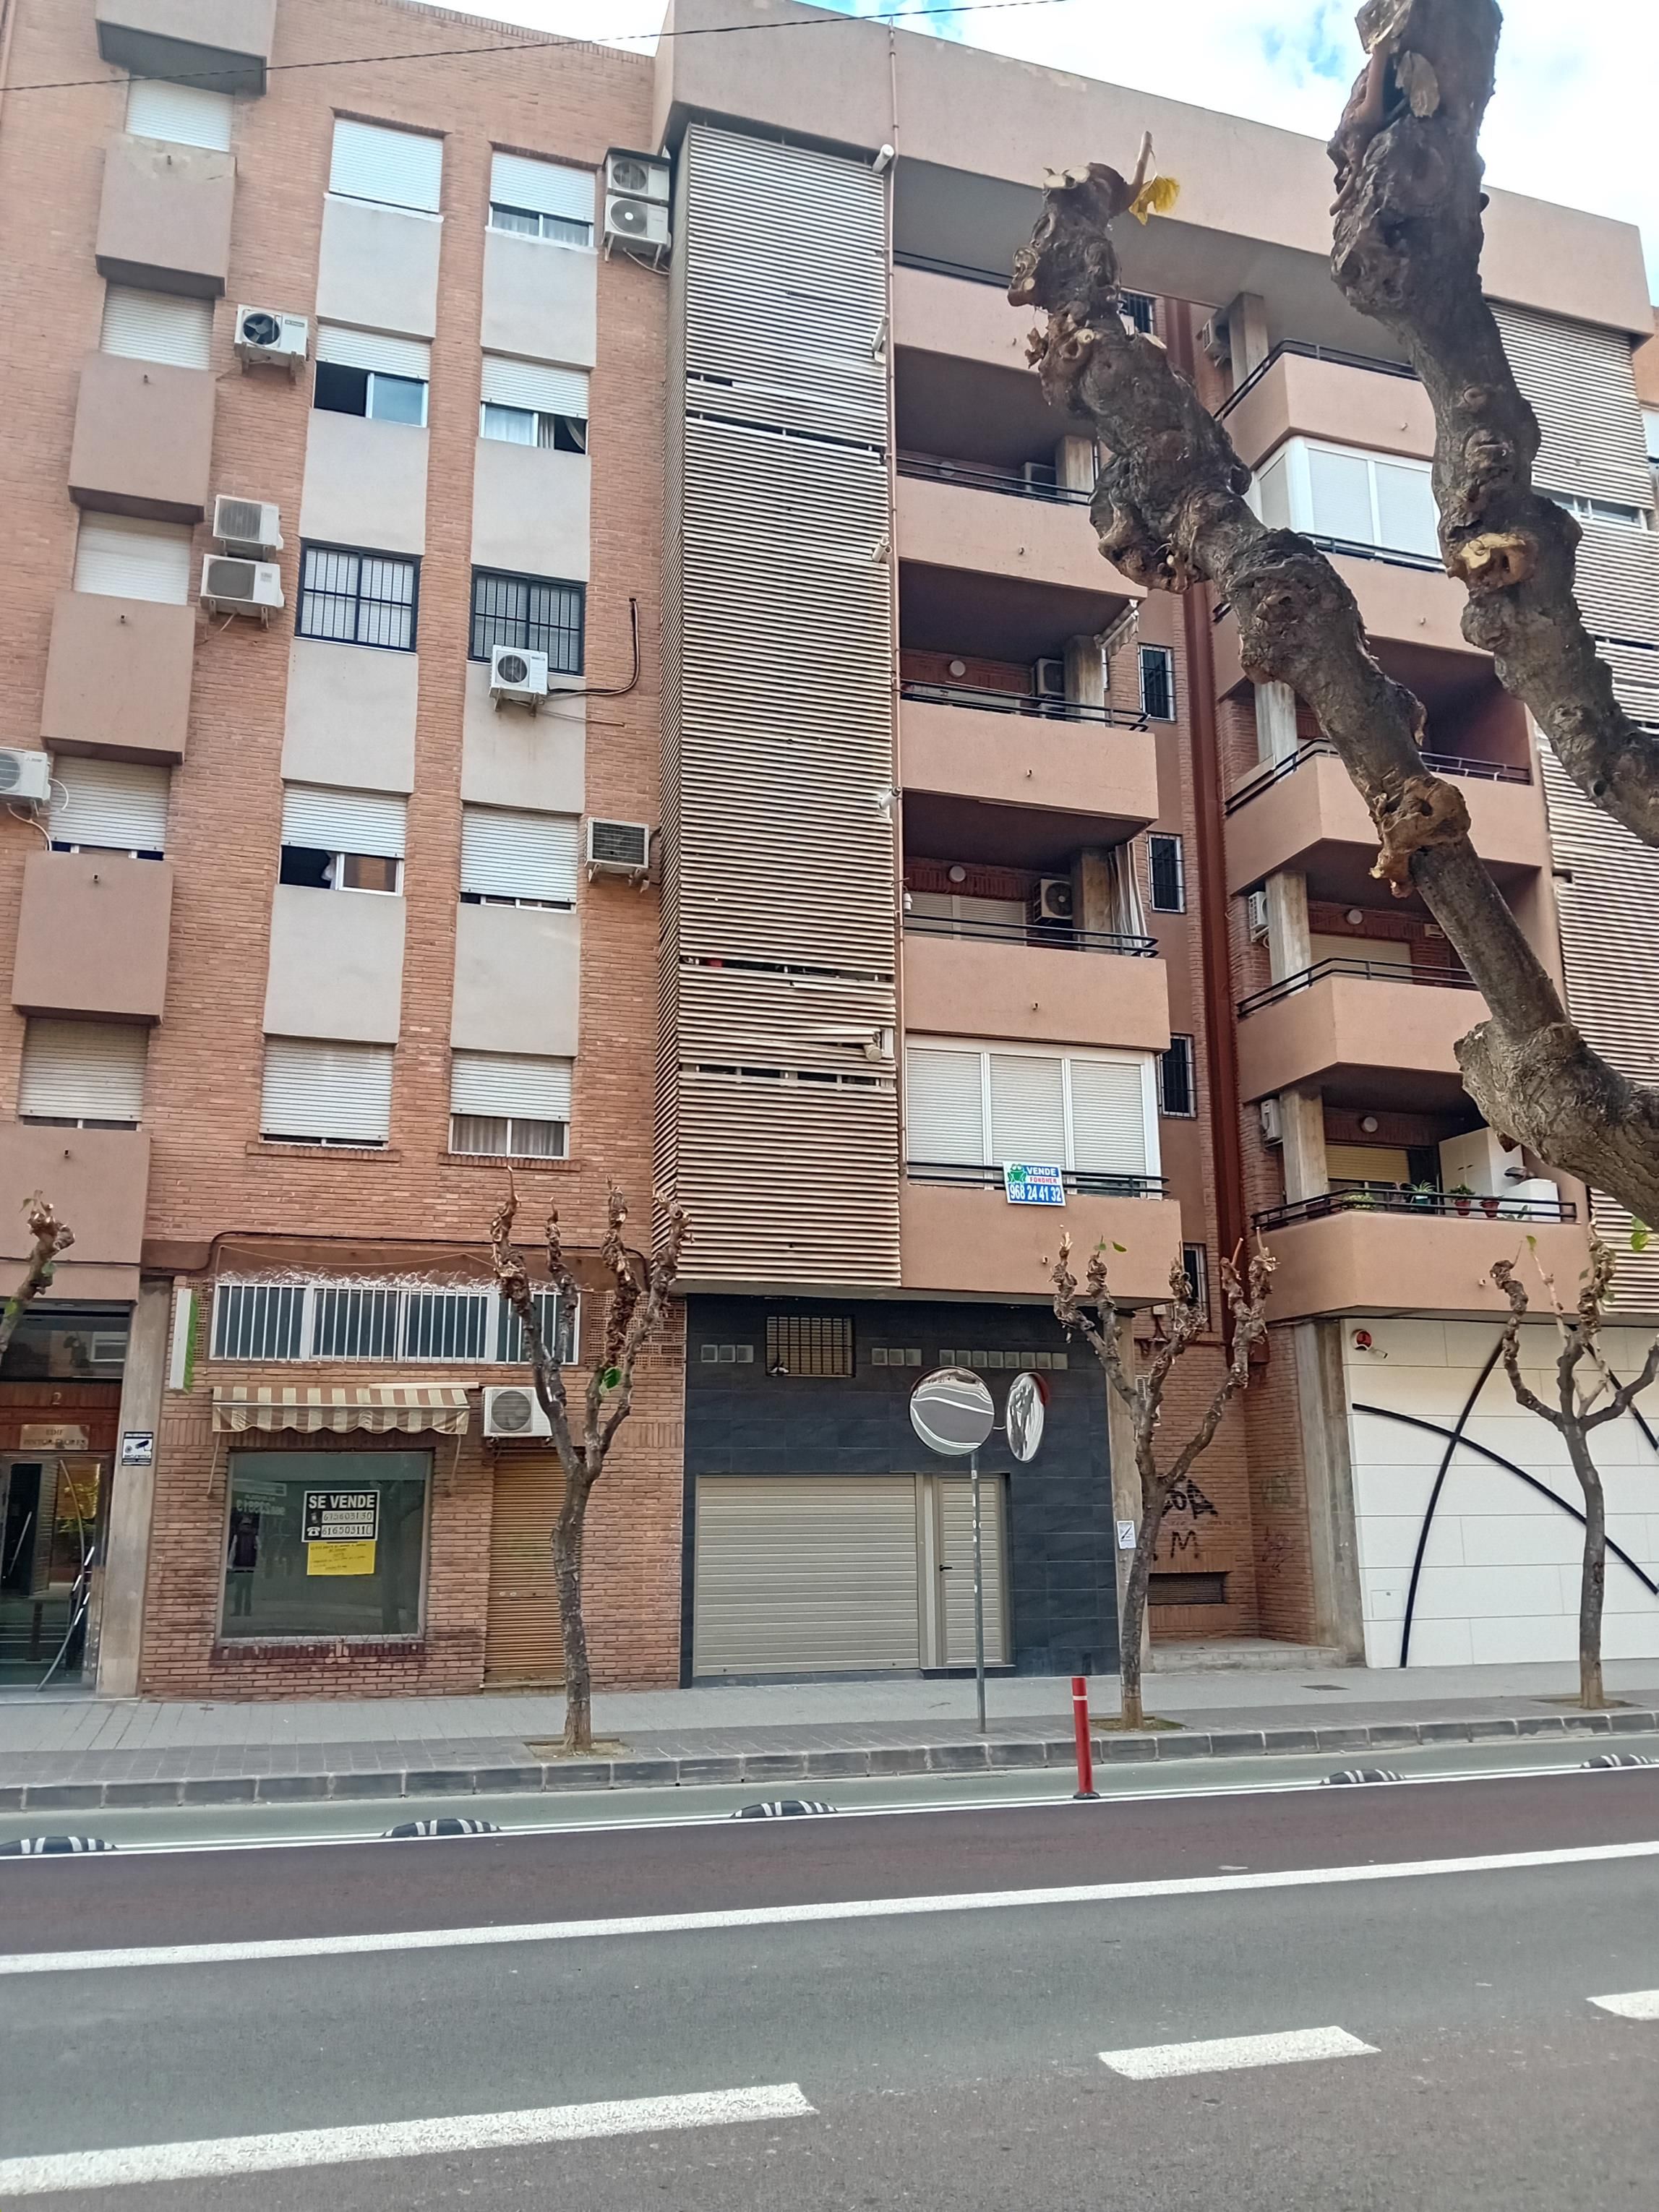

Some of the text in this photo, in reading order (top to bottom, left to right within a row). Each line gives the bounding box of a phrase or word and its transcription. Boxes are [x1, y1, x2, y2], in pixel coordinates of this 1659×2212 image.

[1026, 1167, 1057, 1176] VENDE
[1010, 1184, 1061, 1202] 968 24 41 32
[51, 1392, 61, 1405] 2
[308, 1494, 375, 1509] SE VENDE
